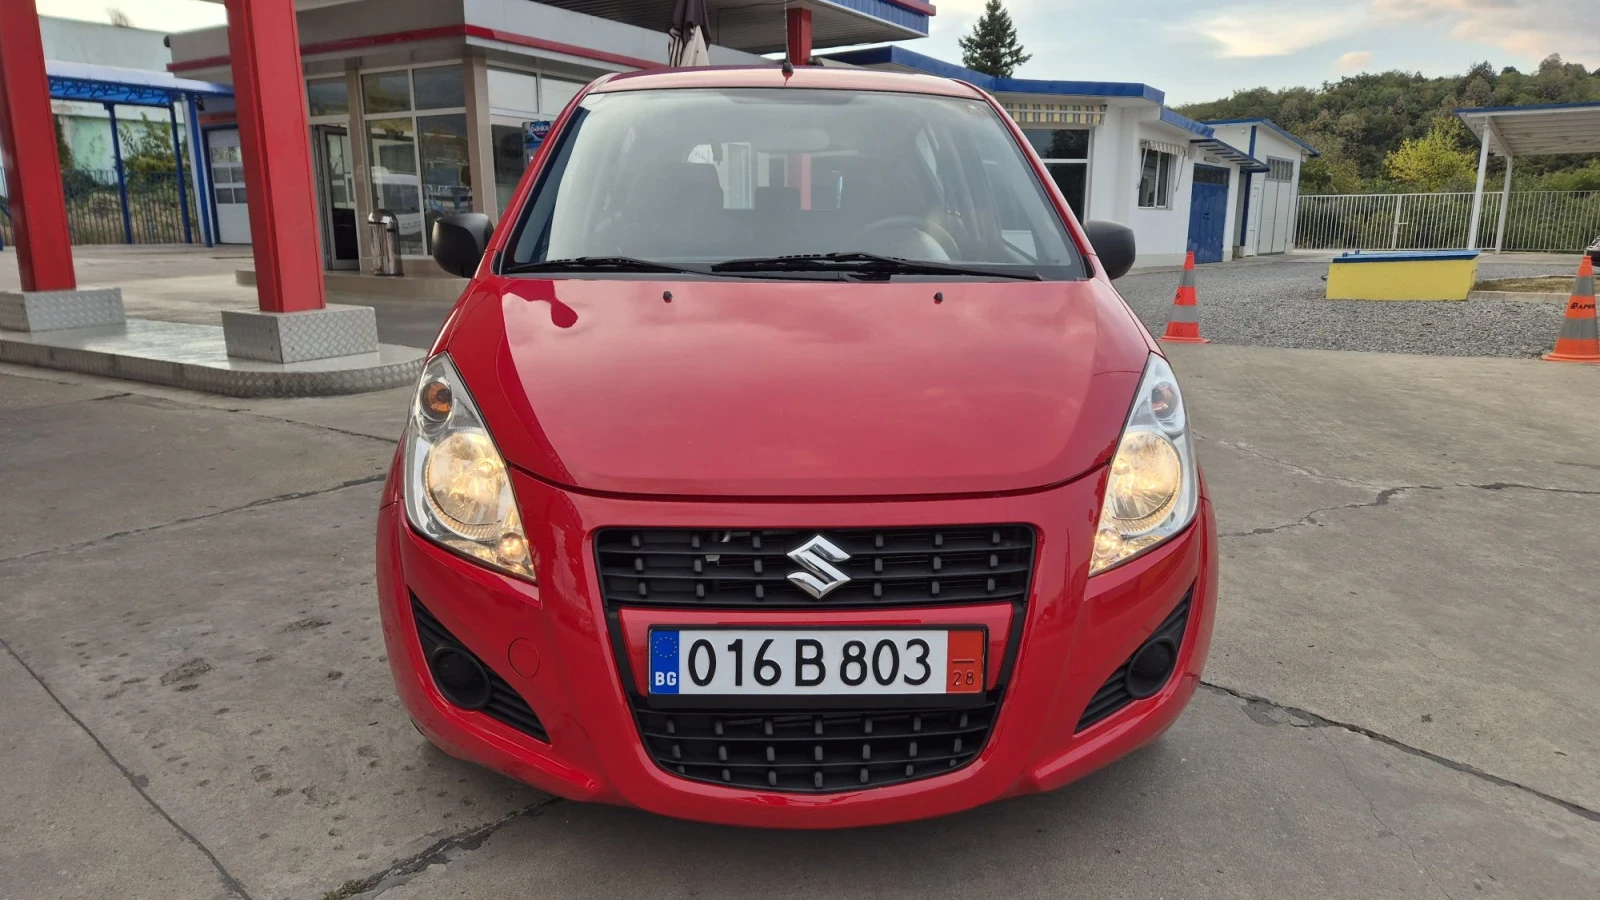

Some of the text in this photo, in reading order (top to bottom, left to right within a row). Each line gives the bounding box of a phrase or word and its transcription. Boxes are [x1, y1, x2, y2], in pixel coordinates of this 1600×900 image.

[688, 639, 932, 687] 016 B 803
[655, 672, 677, 686] BG
[952, 670, 975, 686] 28
